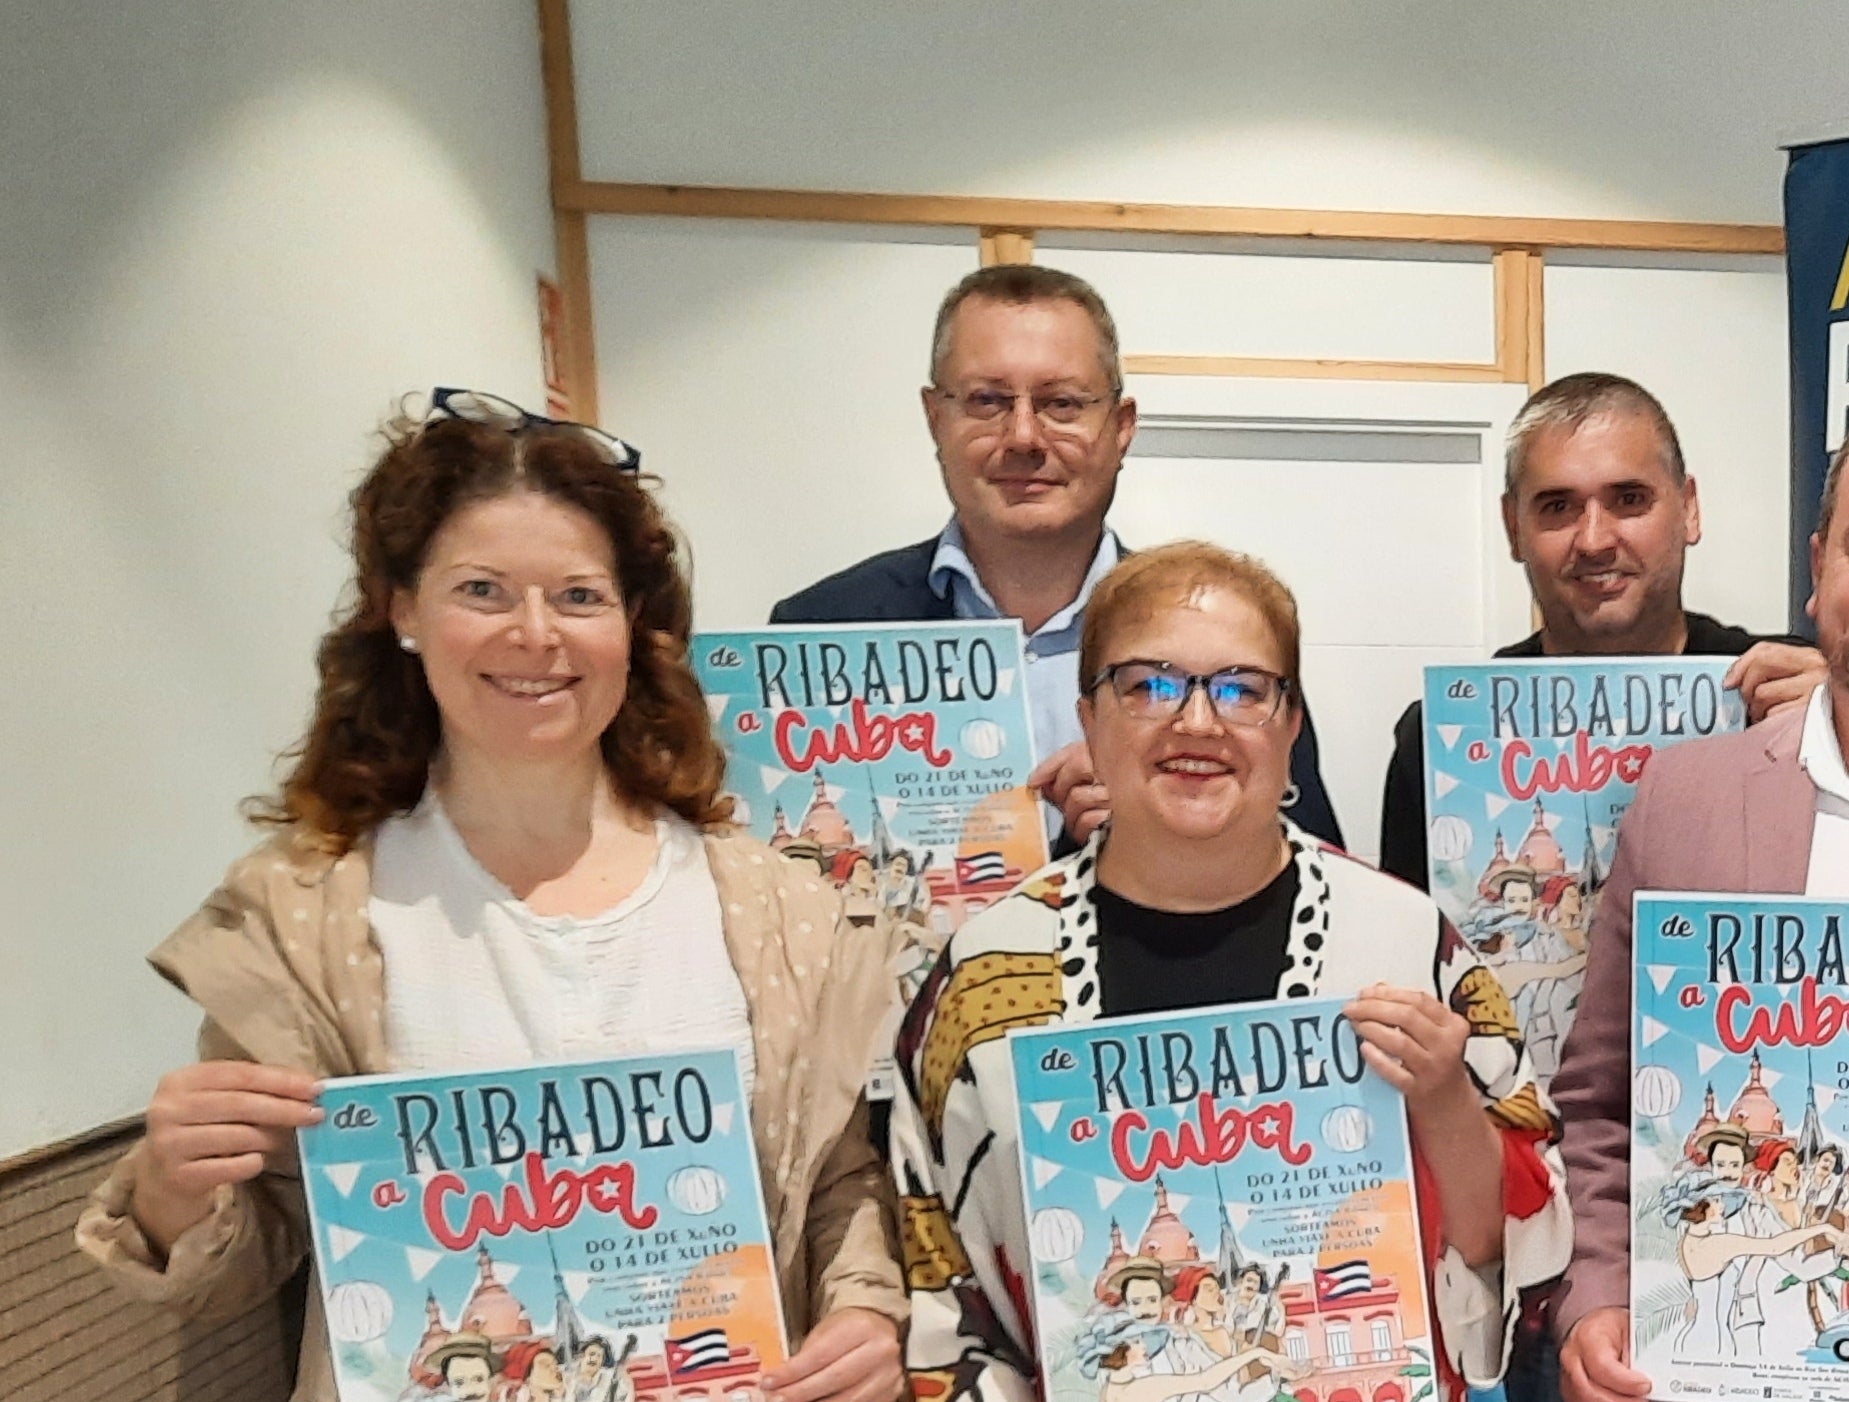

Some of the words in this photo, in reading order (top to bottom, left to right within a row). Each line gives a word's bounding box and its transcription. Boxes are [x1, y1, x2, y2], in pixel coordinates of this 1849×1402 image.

[708, 645, 743, 667] de
[754, 637, 998, 709] RIBADEO
[1447, 678, 1477, 700] de
[1490, 673, 1718, 739] RIBADEO
[735, 713, 762, 733] a
[774, 698, 953, 773] Cuba
[1468, 740, 1489, 762] a
[1502, 730, 1652, 801] Cuba
[1660, 914, 1695, 940] de
[1679, 985, 1705, 1008] a
[1040, 1046, 1077, 1073] de
[1090, 1012, 1367, 1114] RIBADEO
[333, 1101, 377, 1132] de
[394, 1066, 714, 1176] RIBADEO
[1069, 1119, 1097, 1143] a
[1110, 1091, 1313, 1182] Cuba
[371, 1180, 406, 1210] a
[423, 1150, 657, 1250] Cuba
[1247, 1173, 1274, 1187] DO
[1281, 1169, 1299, 1183] 21
[1308, 1166, 1330, 1180] DE
[1272, 1188, 1292, 1202] 14
[1299, 1184, 1321, 1199] DE
[1328, 1178, 1383, 1195] XULLO
